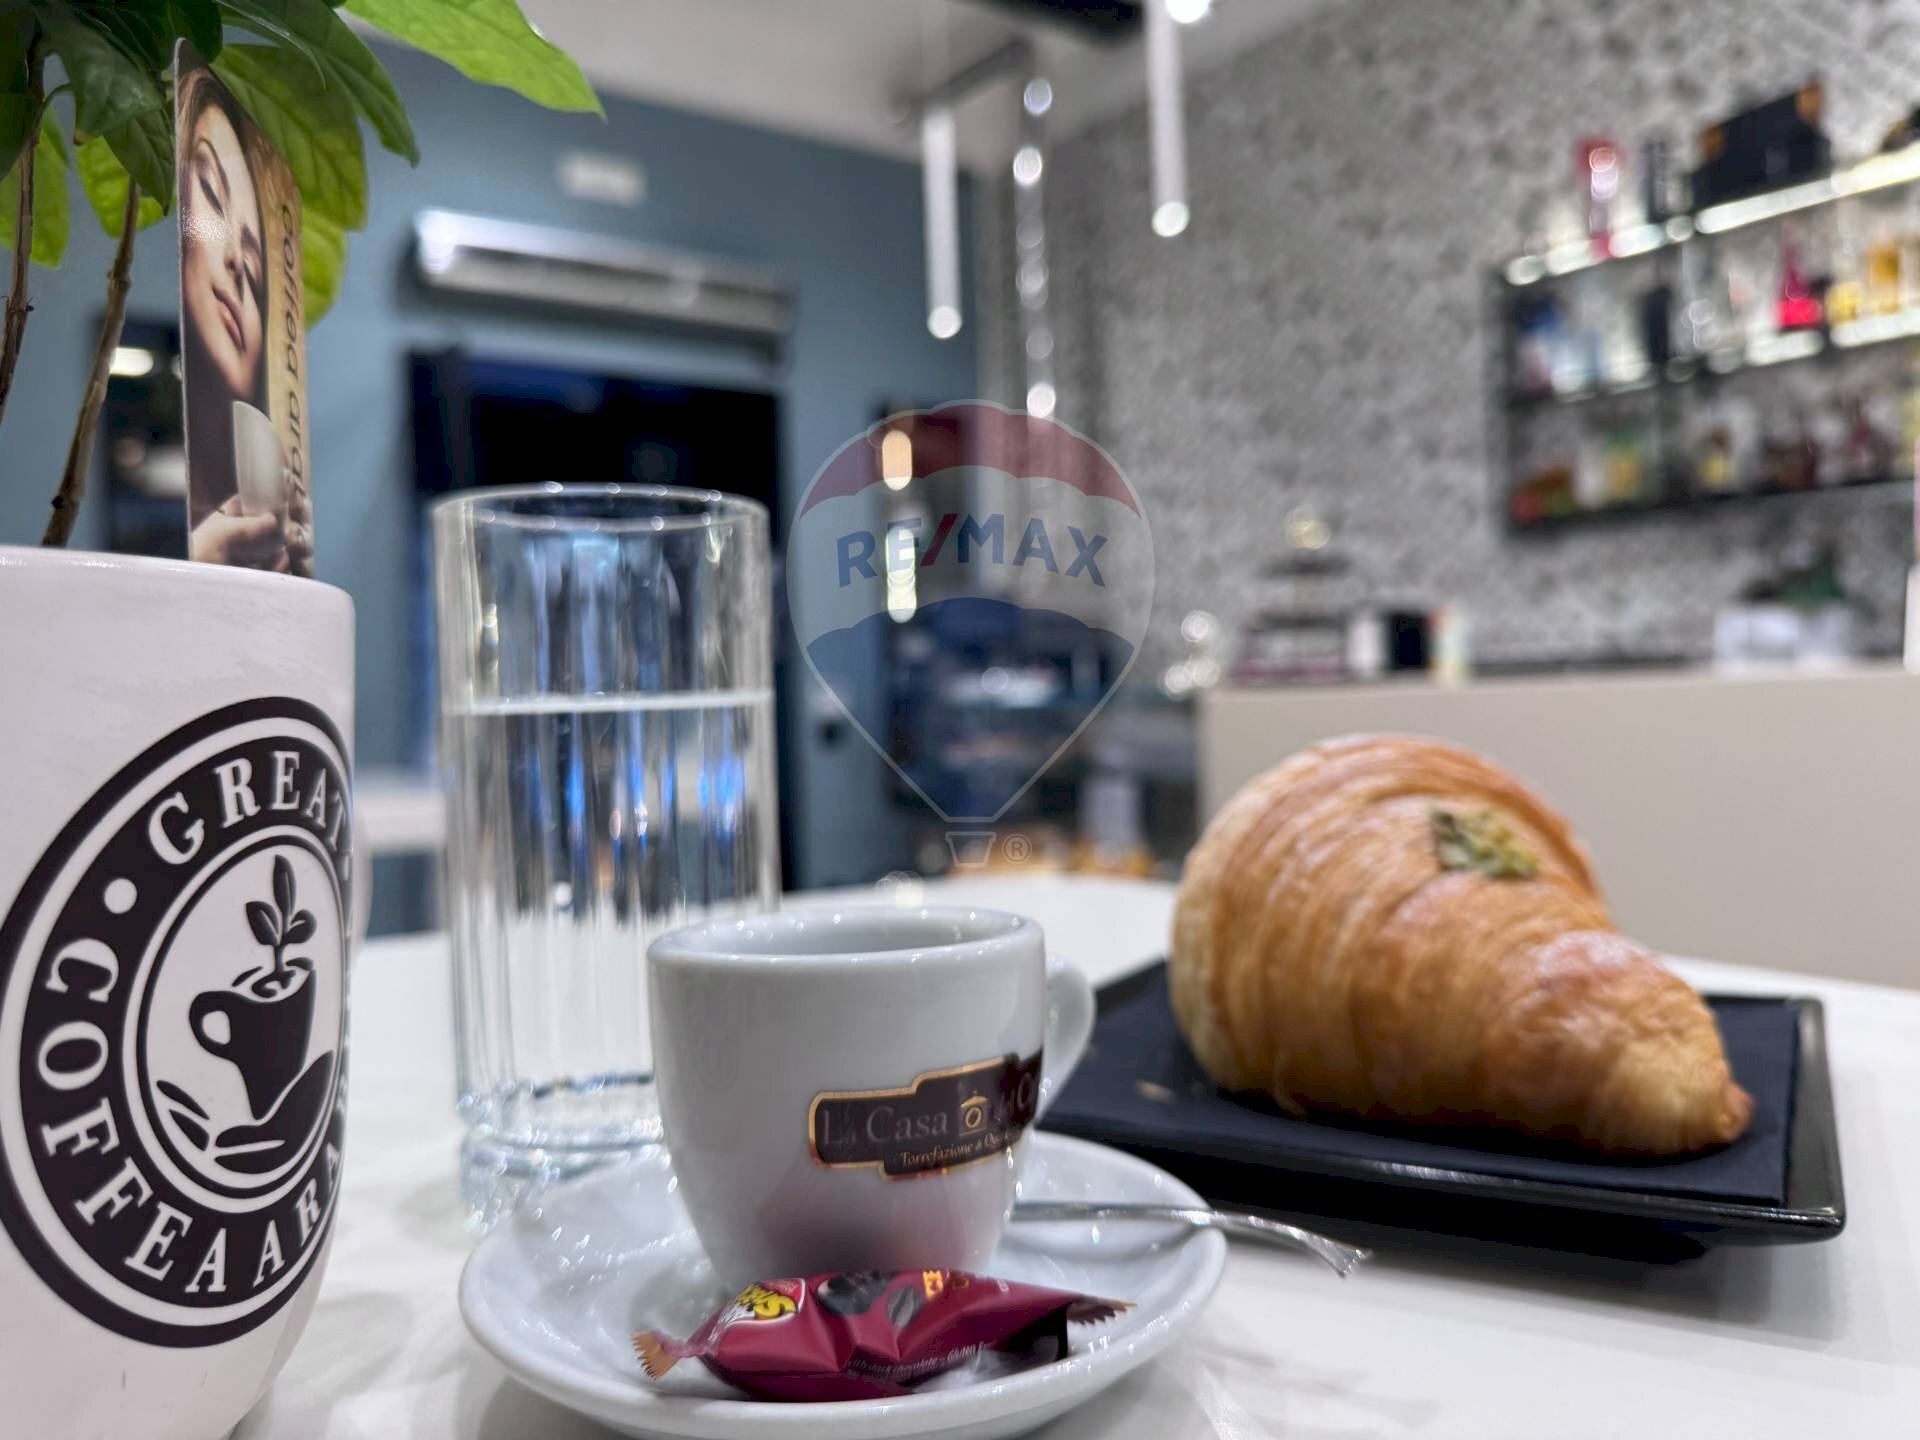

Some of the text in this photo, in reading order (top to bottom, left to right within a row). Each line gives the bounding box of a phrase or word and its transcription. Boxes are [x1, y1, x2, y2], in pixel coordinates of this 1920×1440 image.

[281, 203, 300, 384] coffea
[37, 937, 228, 1294] COFFEA
[865, 1105, 949, 1143] Casa
